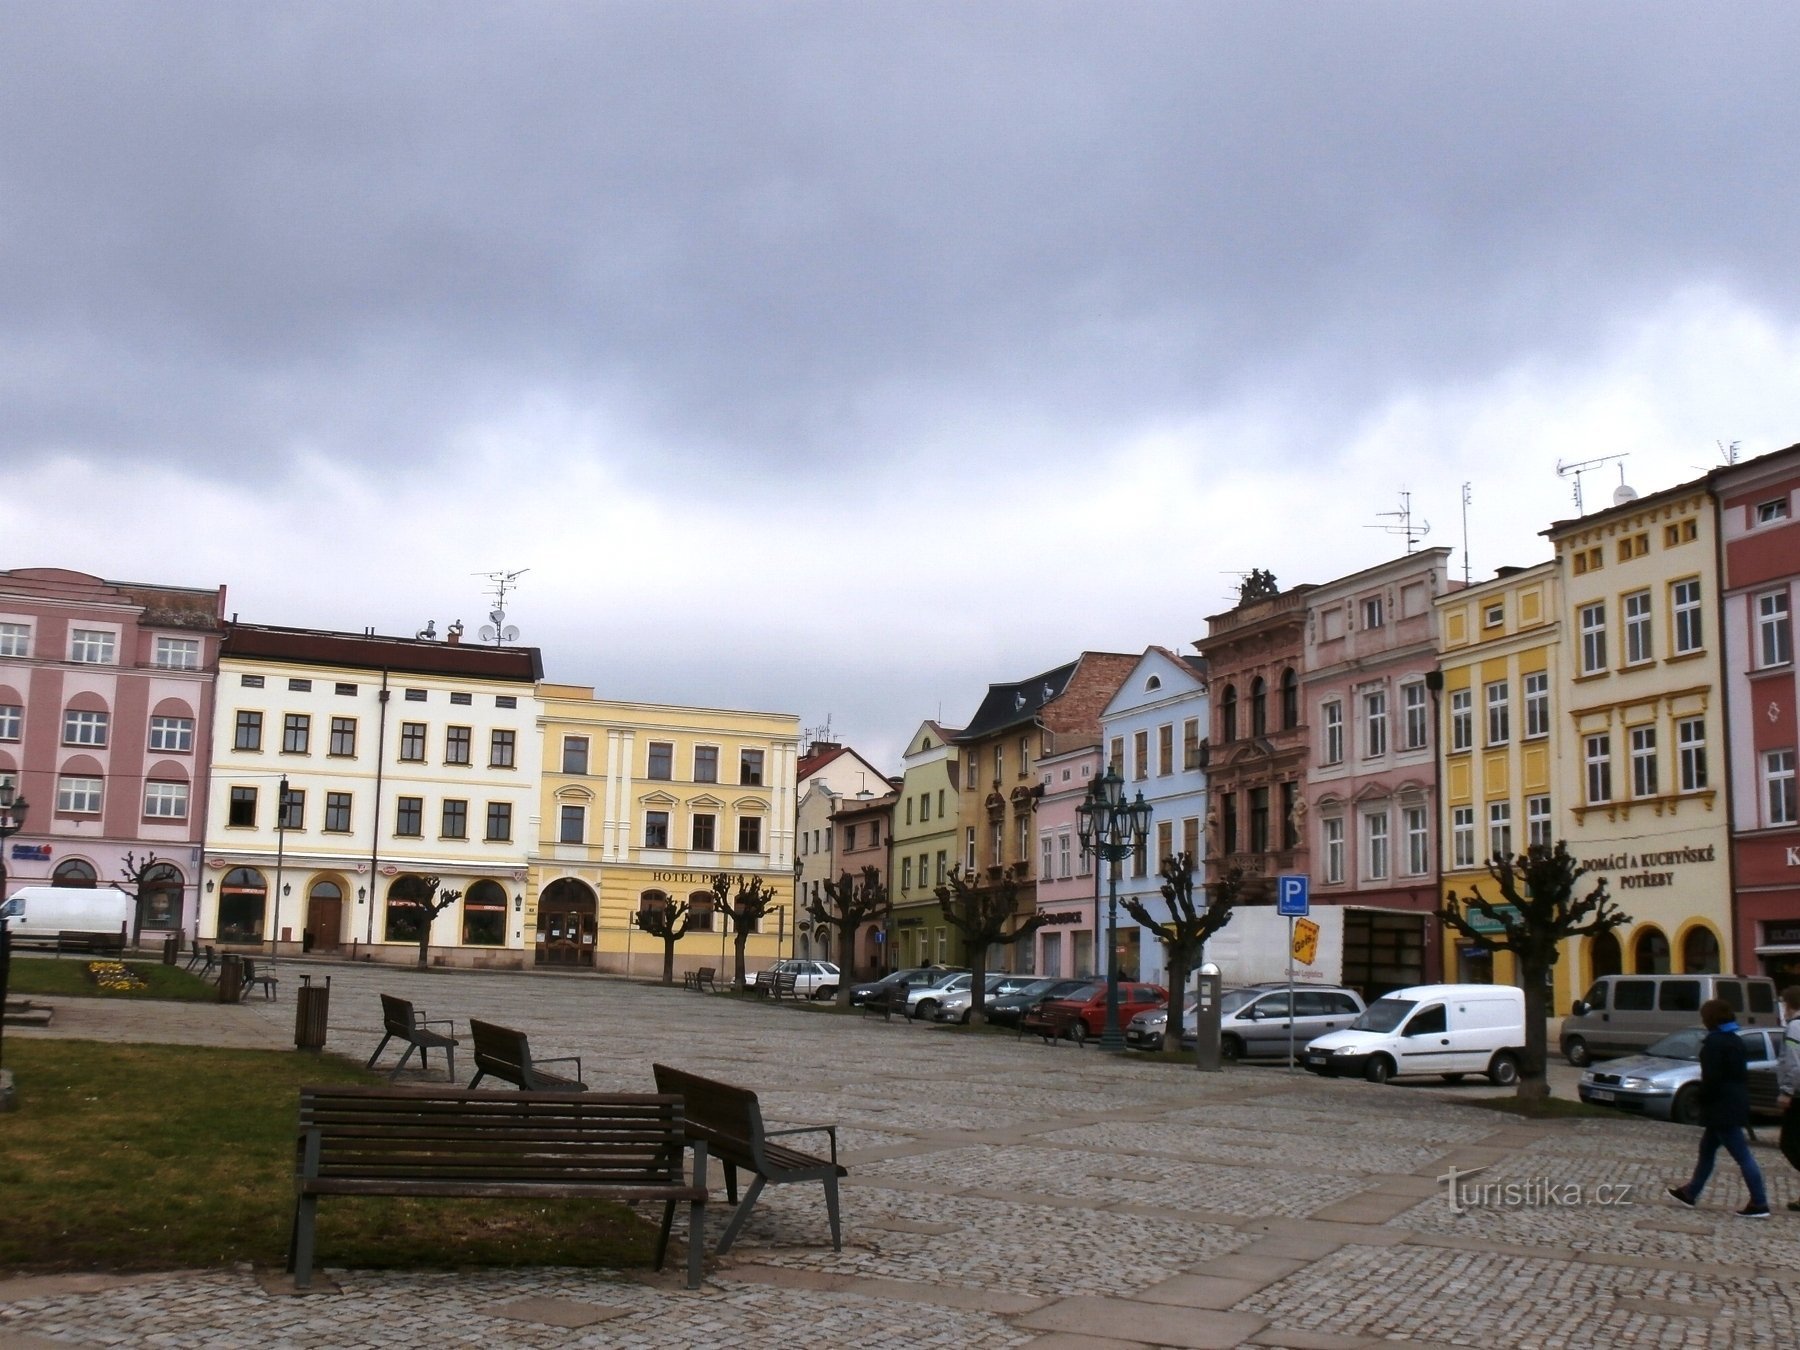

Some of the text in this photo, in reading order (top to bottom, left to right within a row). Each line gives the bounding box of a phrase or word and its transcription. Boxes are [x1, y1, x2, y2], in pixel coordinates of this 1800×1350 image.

[1582, 844, 1715, 872] DOMÁCÍ A KUCHYŇSKÉ
[653, 872, 697, 883] HOTEL
[1620, 870, 1674, 889] POTŘEBY
[1286, 880, 1302, 903] P
